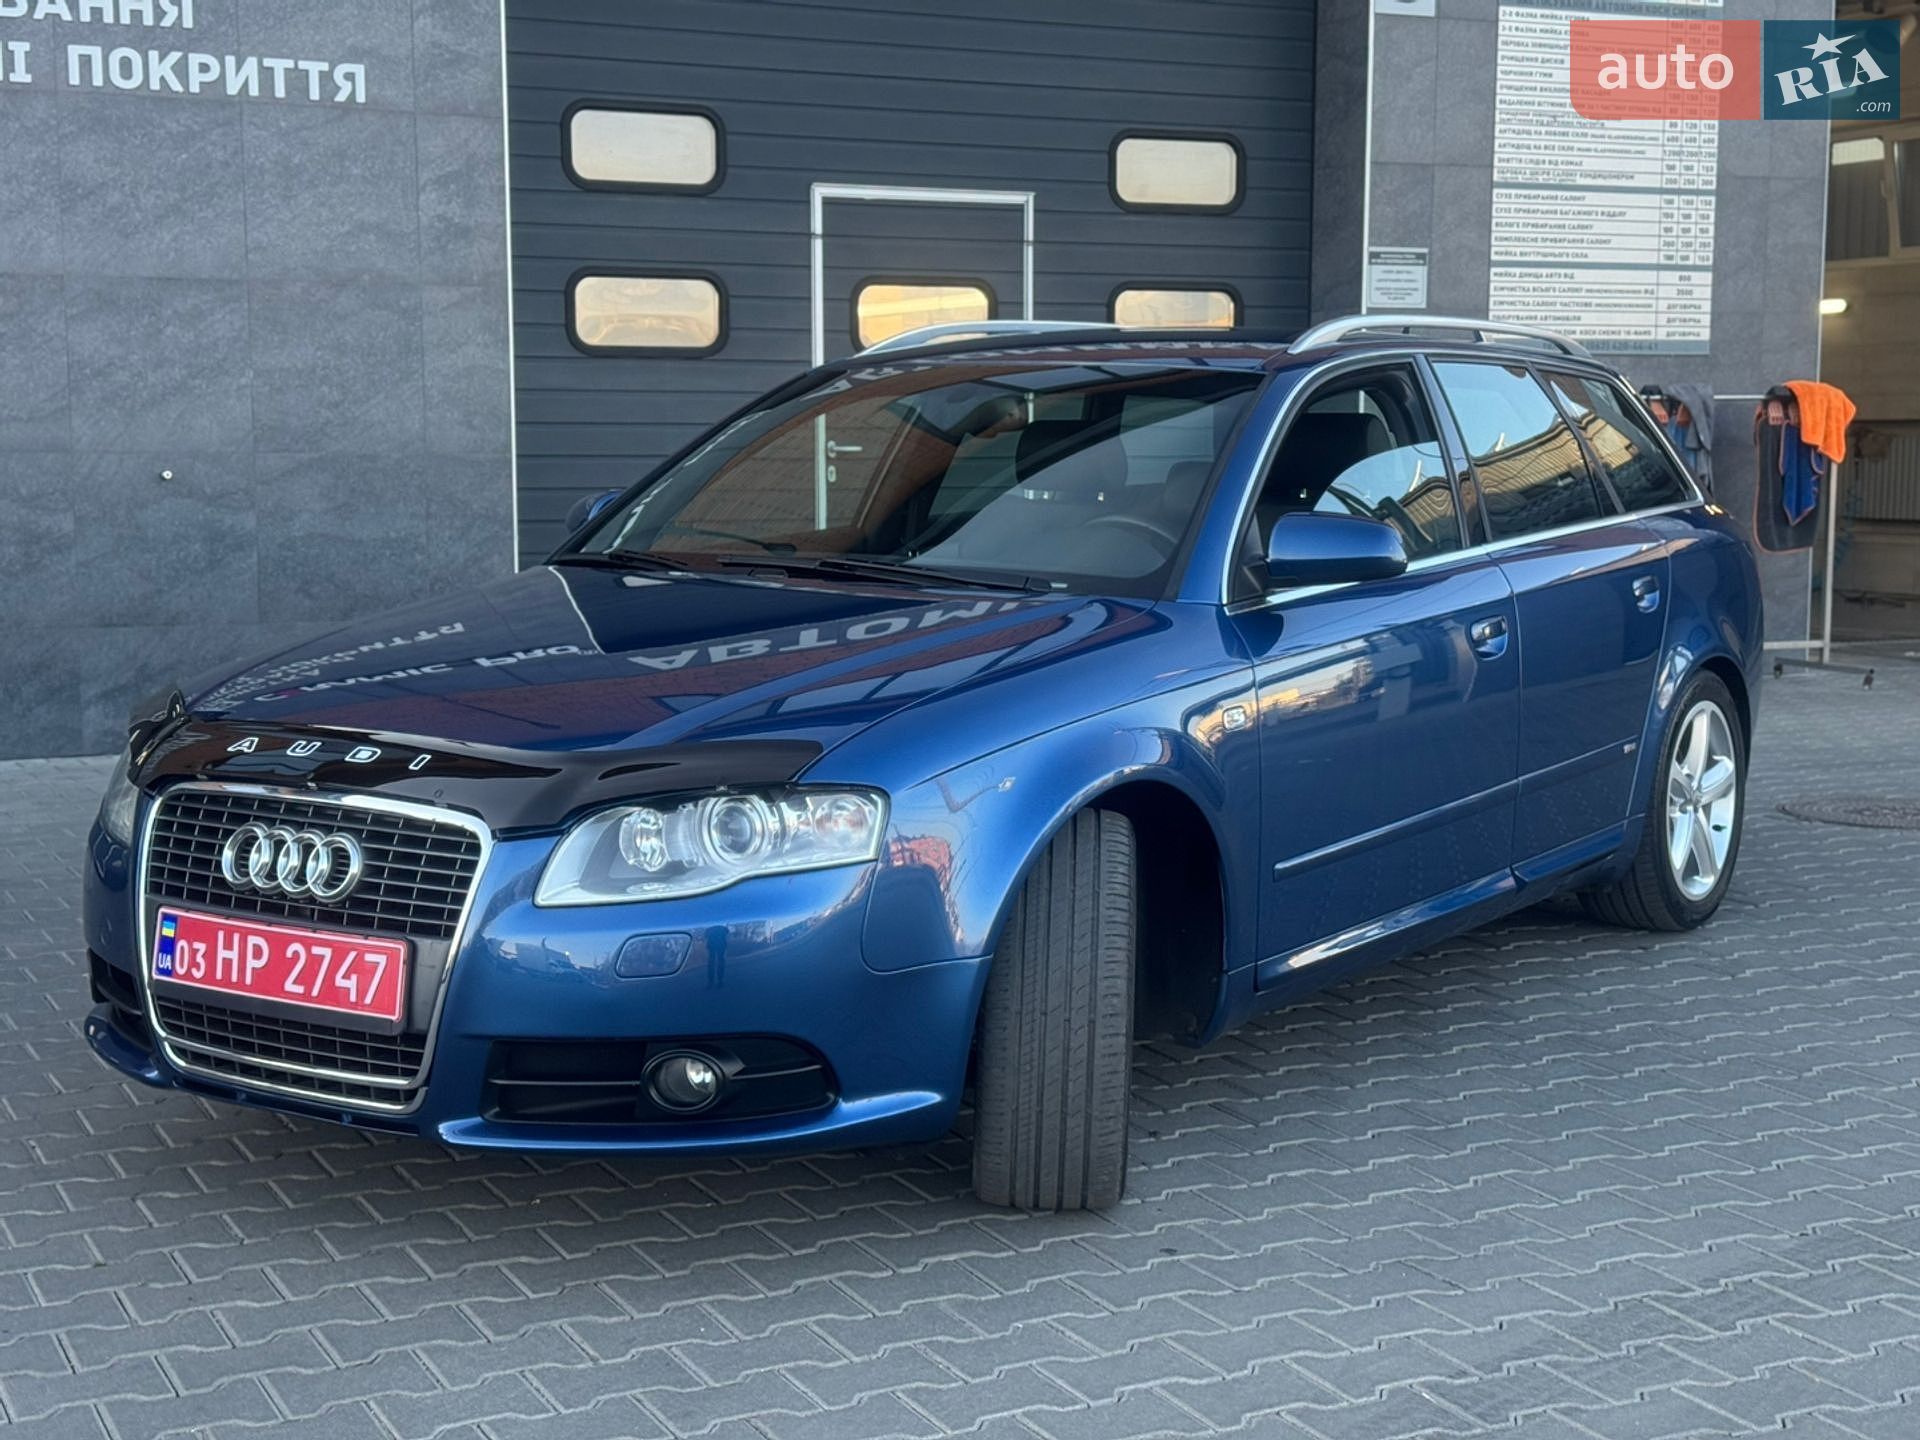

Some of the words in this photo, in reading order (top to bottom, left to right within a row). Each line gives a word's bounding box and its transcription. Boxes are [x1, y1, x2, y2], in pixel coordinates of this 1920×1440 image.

[1540, 12, 1562, 20] МИЙКА
[1539, 27, 1562, 35] МИЙКА
[1500, 54, 1538, 63] ОЧИЩЕННЯ
[67, 44, 367, 103] ПОКРИТТЯ
[1499, 84, 1537, 92] ОЧИЩЕННЯ
[1514, 193, 1558, 201] ПРИБИРАННЯ
[1513, 207, 1557, 215] ПРИБИРАННЯ
[1522, 222, 1565, 230] ПРИБИРАННЯ
[1494, 249, 1517, 257] МИЙКА
[227, 736, 432, 771] AUDI
[158, 953, 172, 970] UA
[175, 939, 206, 979] 03
[216, 930, 270, 985] HP
[283, 942, 388, 1005] 2747
